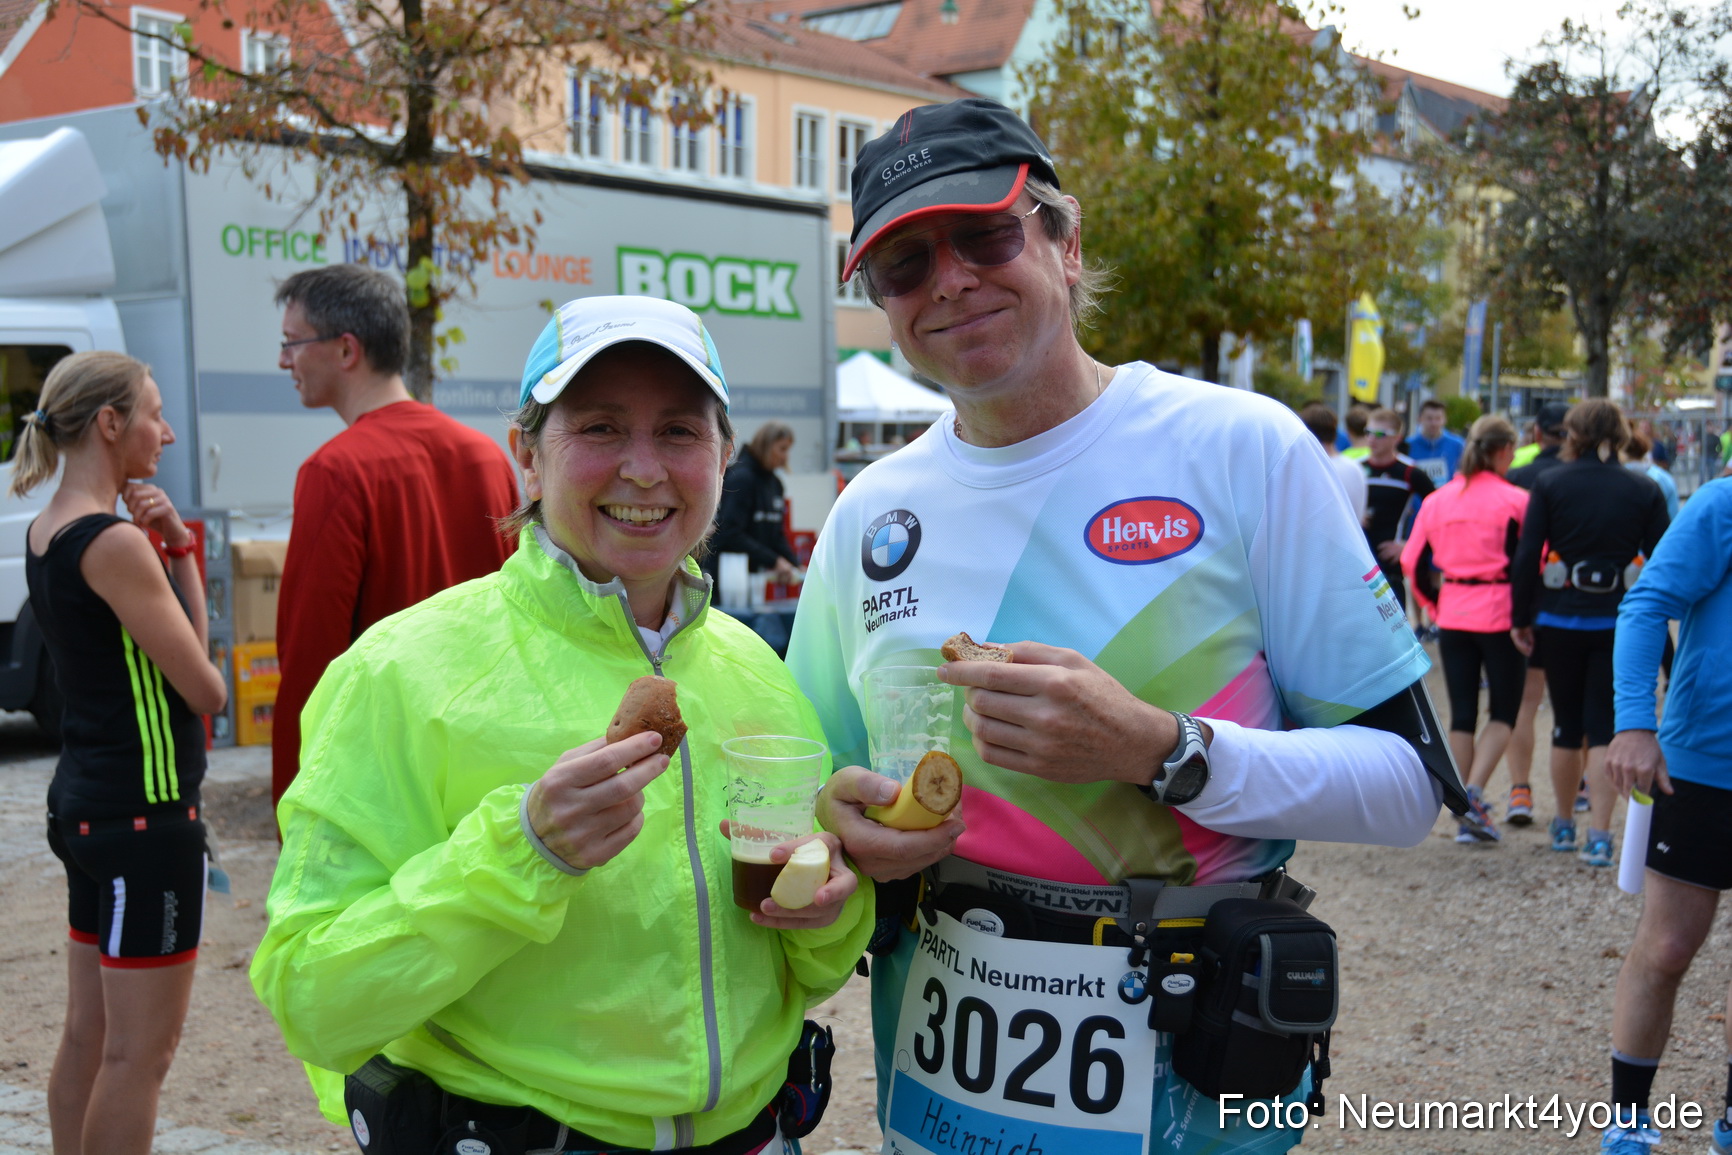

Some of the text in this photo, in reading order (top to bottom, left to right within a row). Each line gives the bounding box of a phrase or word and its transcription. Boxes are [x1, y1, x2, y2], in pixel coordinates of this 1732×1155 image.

[881, 147, 931, 180] GORE
[884, 158, 932, 188] RUNNING WEAR
[221, 223, 328, 264] OFFICE
[493, 250, 593, 286] LOUNGE
[616, 245, 803, 320] BOCK
[866, 511, 918, 539] BMW
[1102, 514, 1190, 544] Hervis
[1107, 541, 1150, 553] SPORTS
[862, 586, 919, 620] PARTL
[864, 605, 917, 635] Neumarkt
[988, 879, 1122, 913] NATHAN
[1040, 881, 1091, 896] PROPULSION
[1092, 889, 1123, 897] HUMAN
[966, 918, 982, 927] Fuel
[980, 924, 996, 932] Belt
[920, 928, 1105, 998] PARTL Neumarkt
[1121, 971, 1148, 984] BMW
[914, 976, 1125, 1115] 3026
